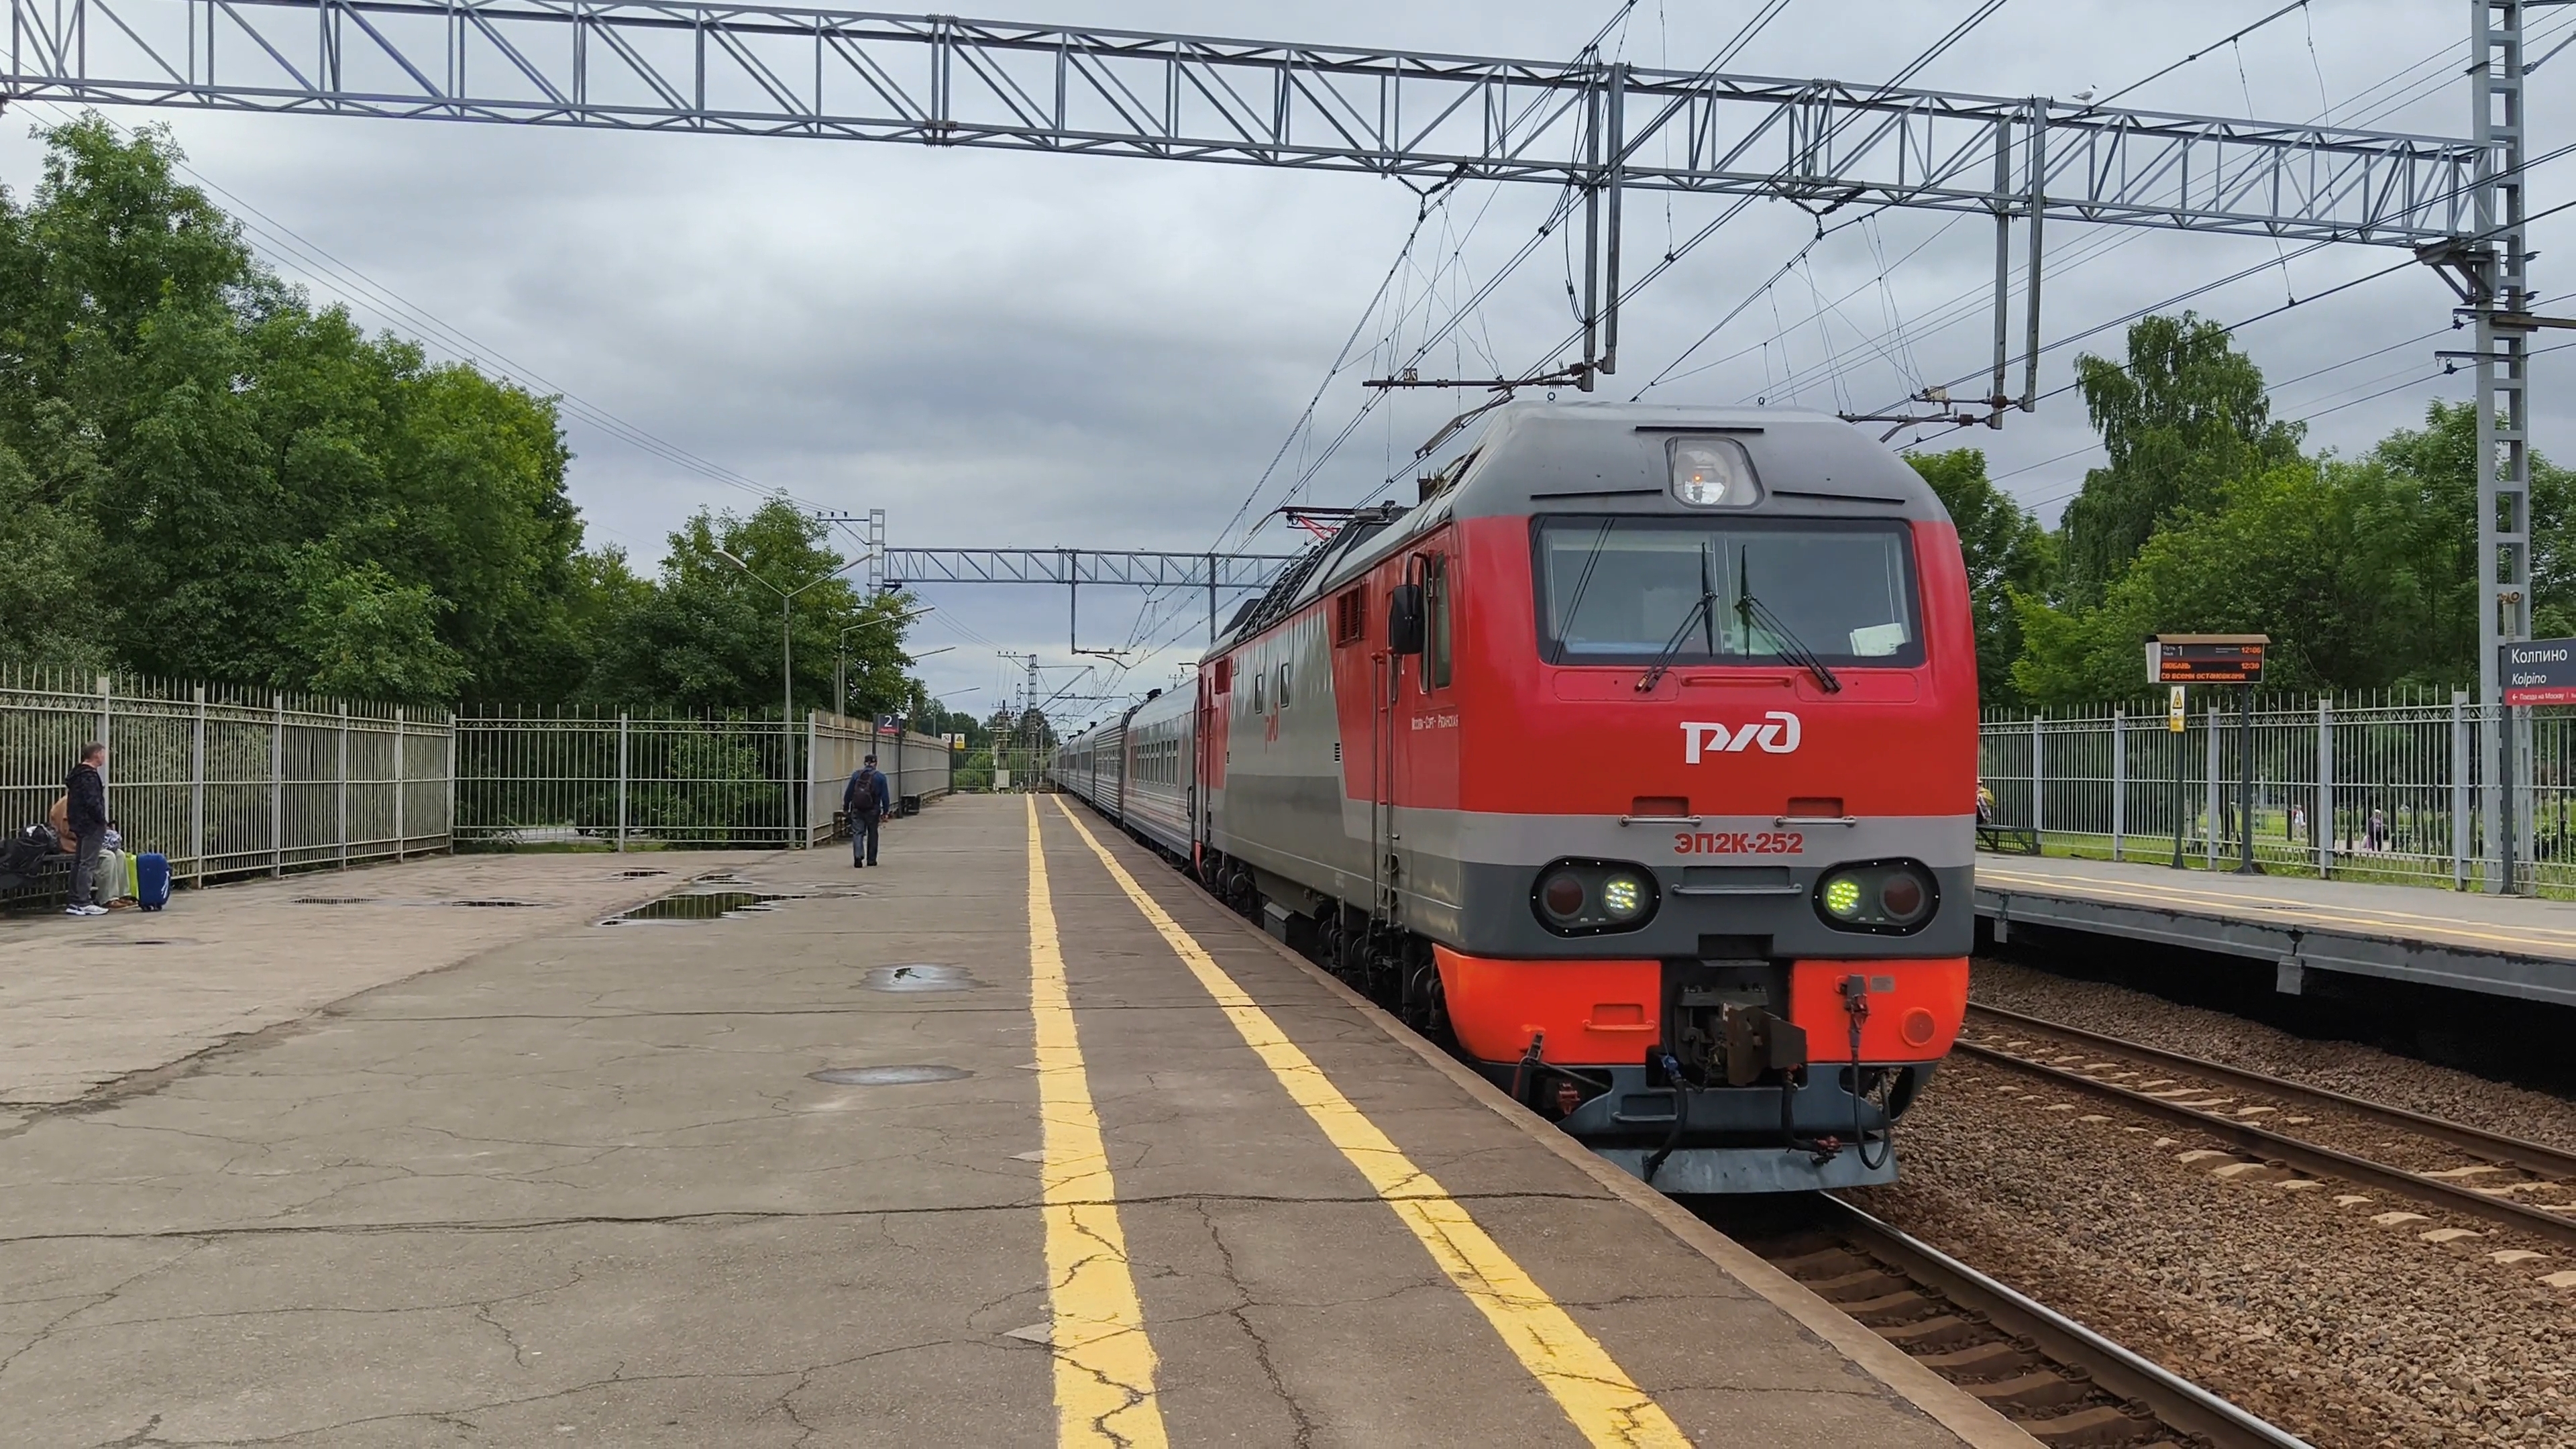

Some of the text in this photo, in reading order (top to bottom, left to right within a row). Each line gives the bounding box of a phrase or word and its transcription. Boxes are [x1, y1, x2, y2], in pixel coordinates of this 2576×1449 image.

[2178, 645, 2183, 656] 1
[2512, 649, 2568, 664] Колпино
[2512, 672, 2547, 688] Kolpino
[884, 715, 893, 727] 2
[1674, 833, 1803, 854] ЭП2К-252
